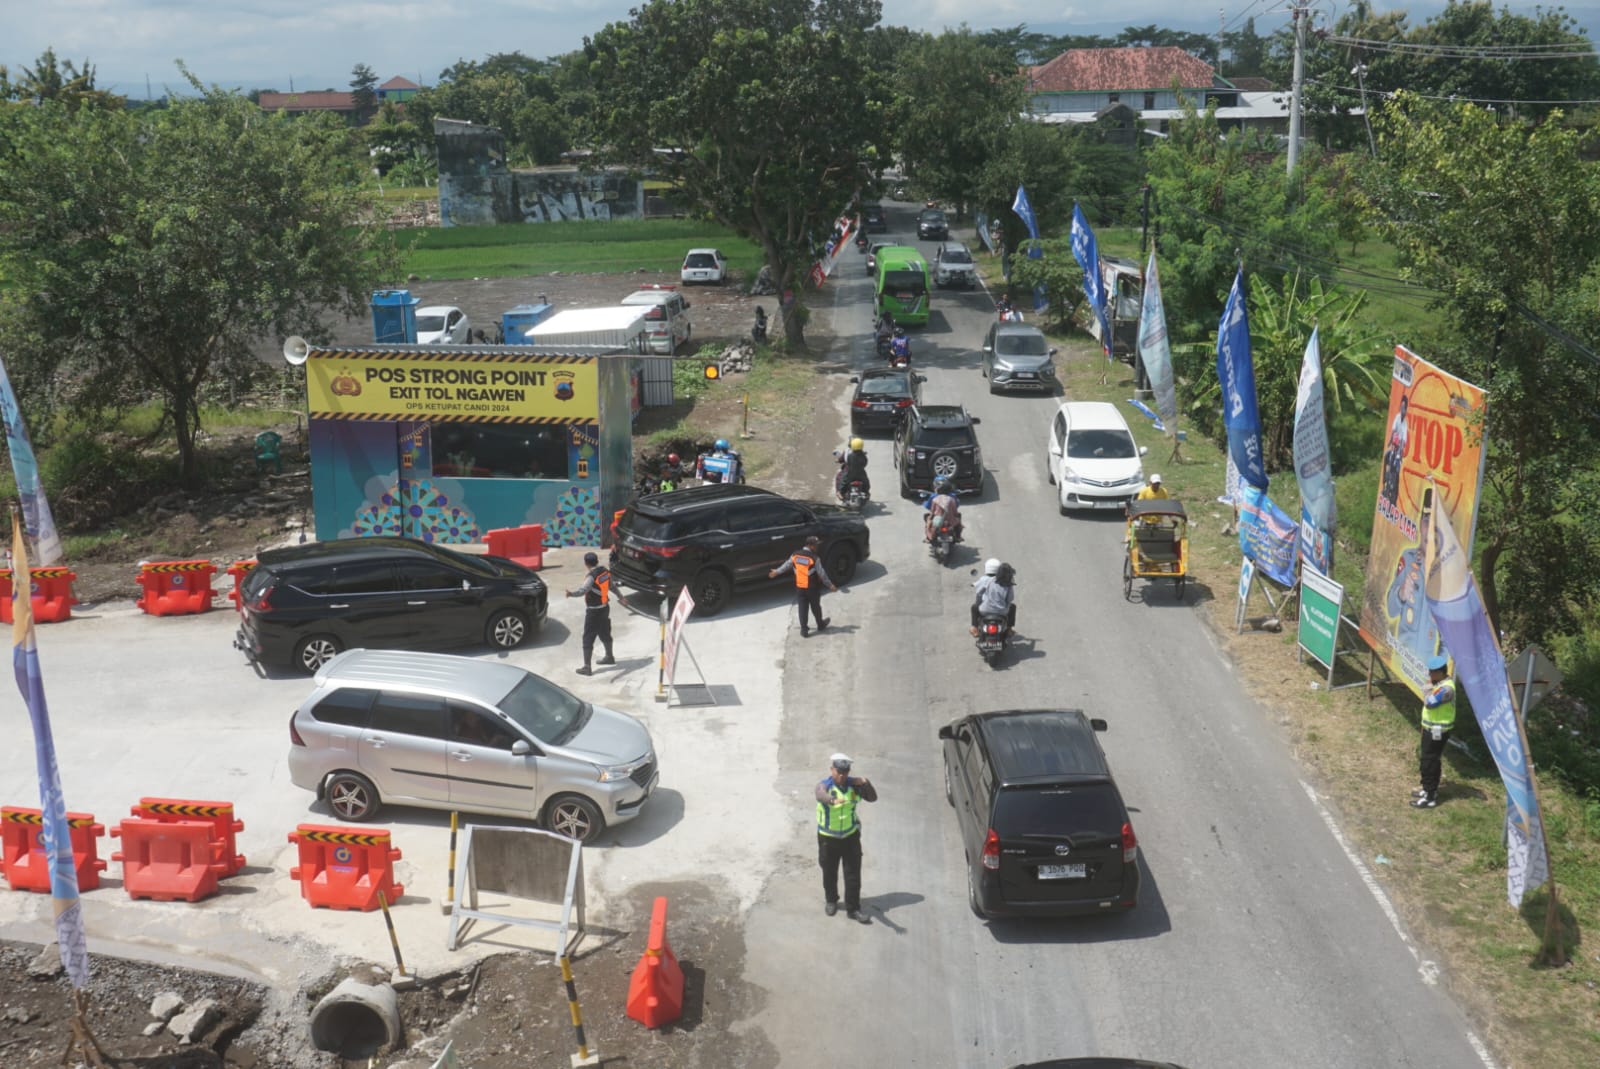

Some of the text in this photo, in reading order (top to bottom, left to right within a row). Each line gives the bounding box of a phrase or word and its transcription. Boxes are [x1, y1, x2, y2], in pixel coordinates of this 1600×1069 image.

[365, 367, 547, 386] POS STRONG POINT
[389, 386, 526, 402] EXIT TOL NGAWEN
[406, 402, 510, 412] OPS KETUPAT CANDI 2024
